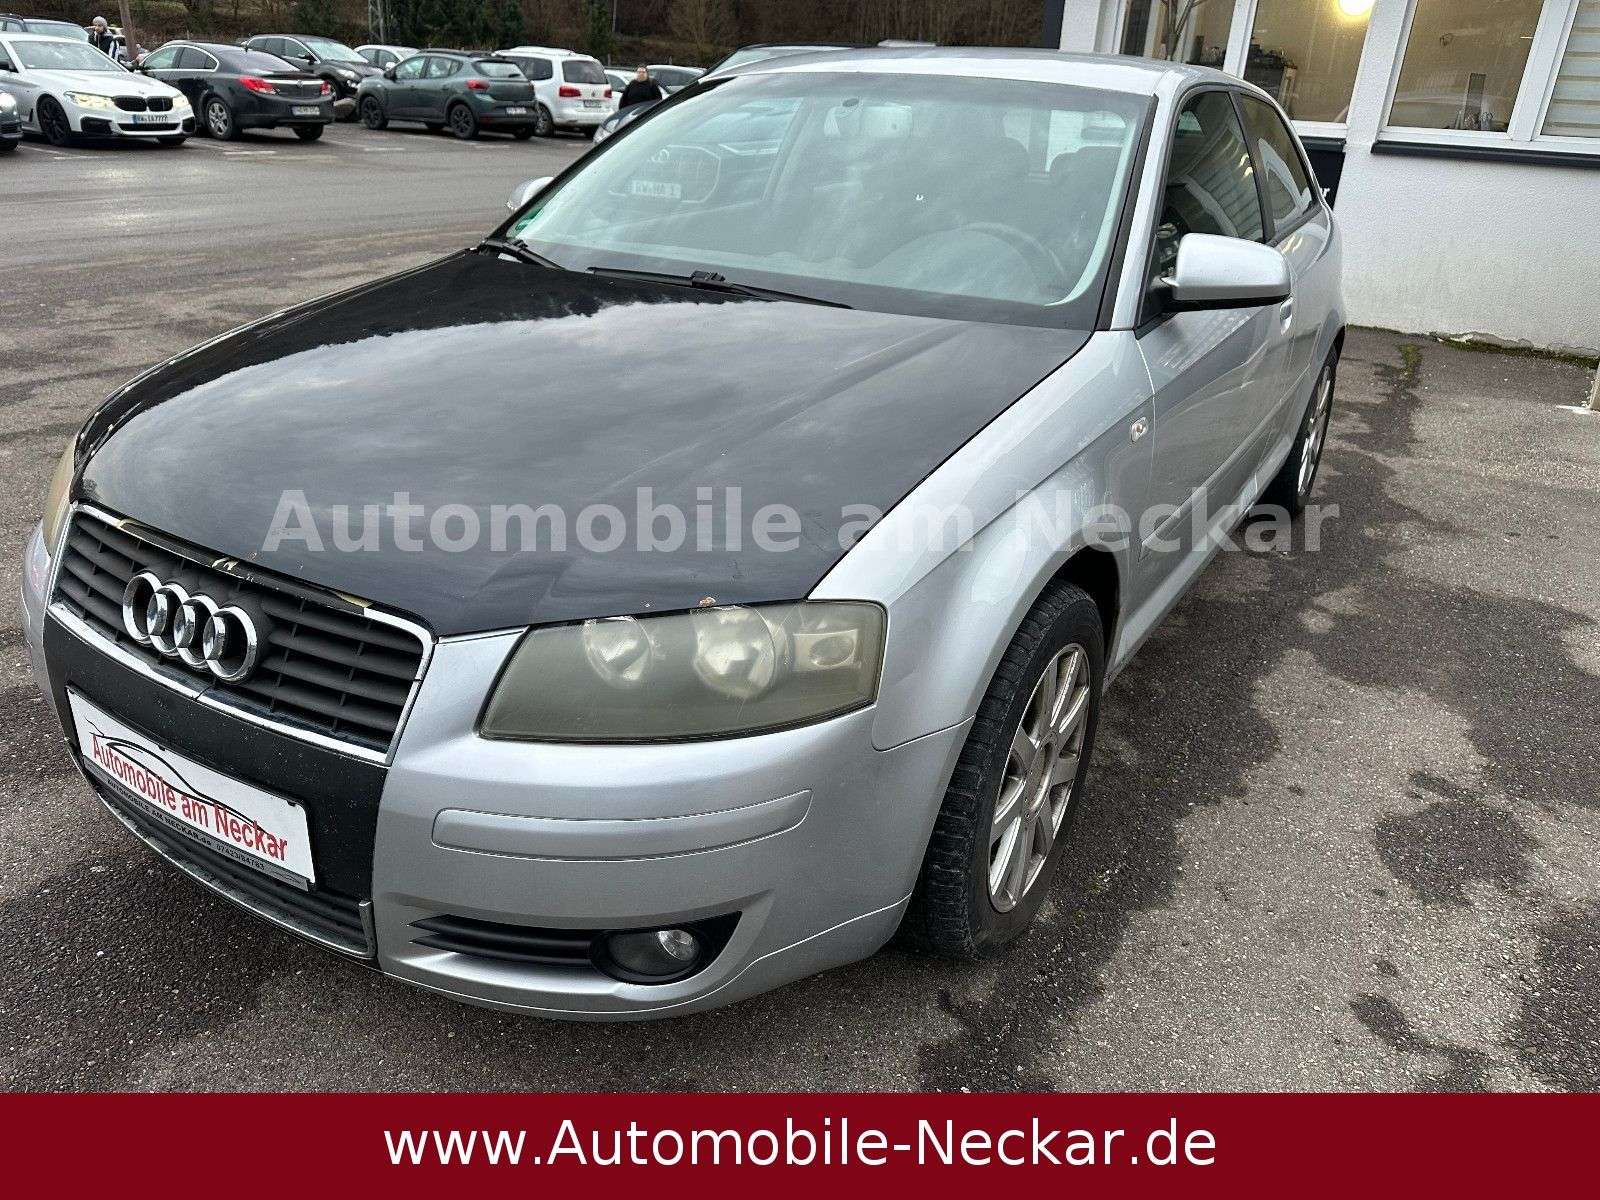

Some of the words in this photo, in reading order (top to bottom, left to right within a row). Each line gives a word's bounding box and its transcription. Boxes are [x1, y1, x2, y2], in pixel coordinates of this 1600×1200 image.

[93, 734, 177, 811] Automobile
[180, 793, 209, 828] am
[213, 804, 288, 861] Neckar
